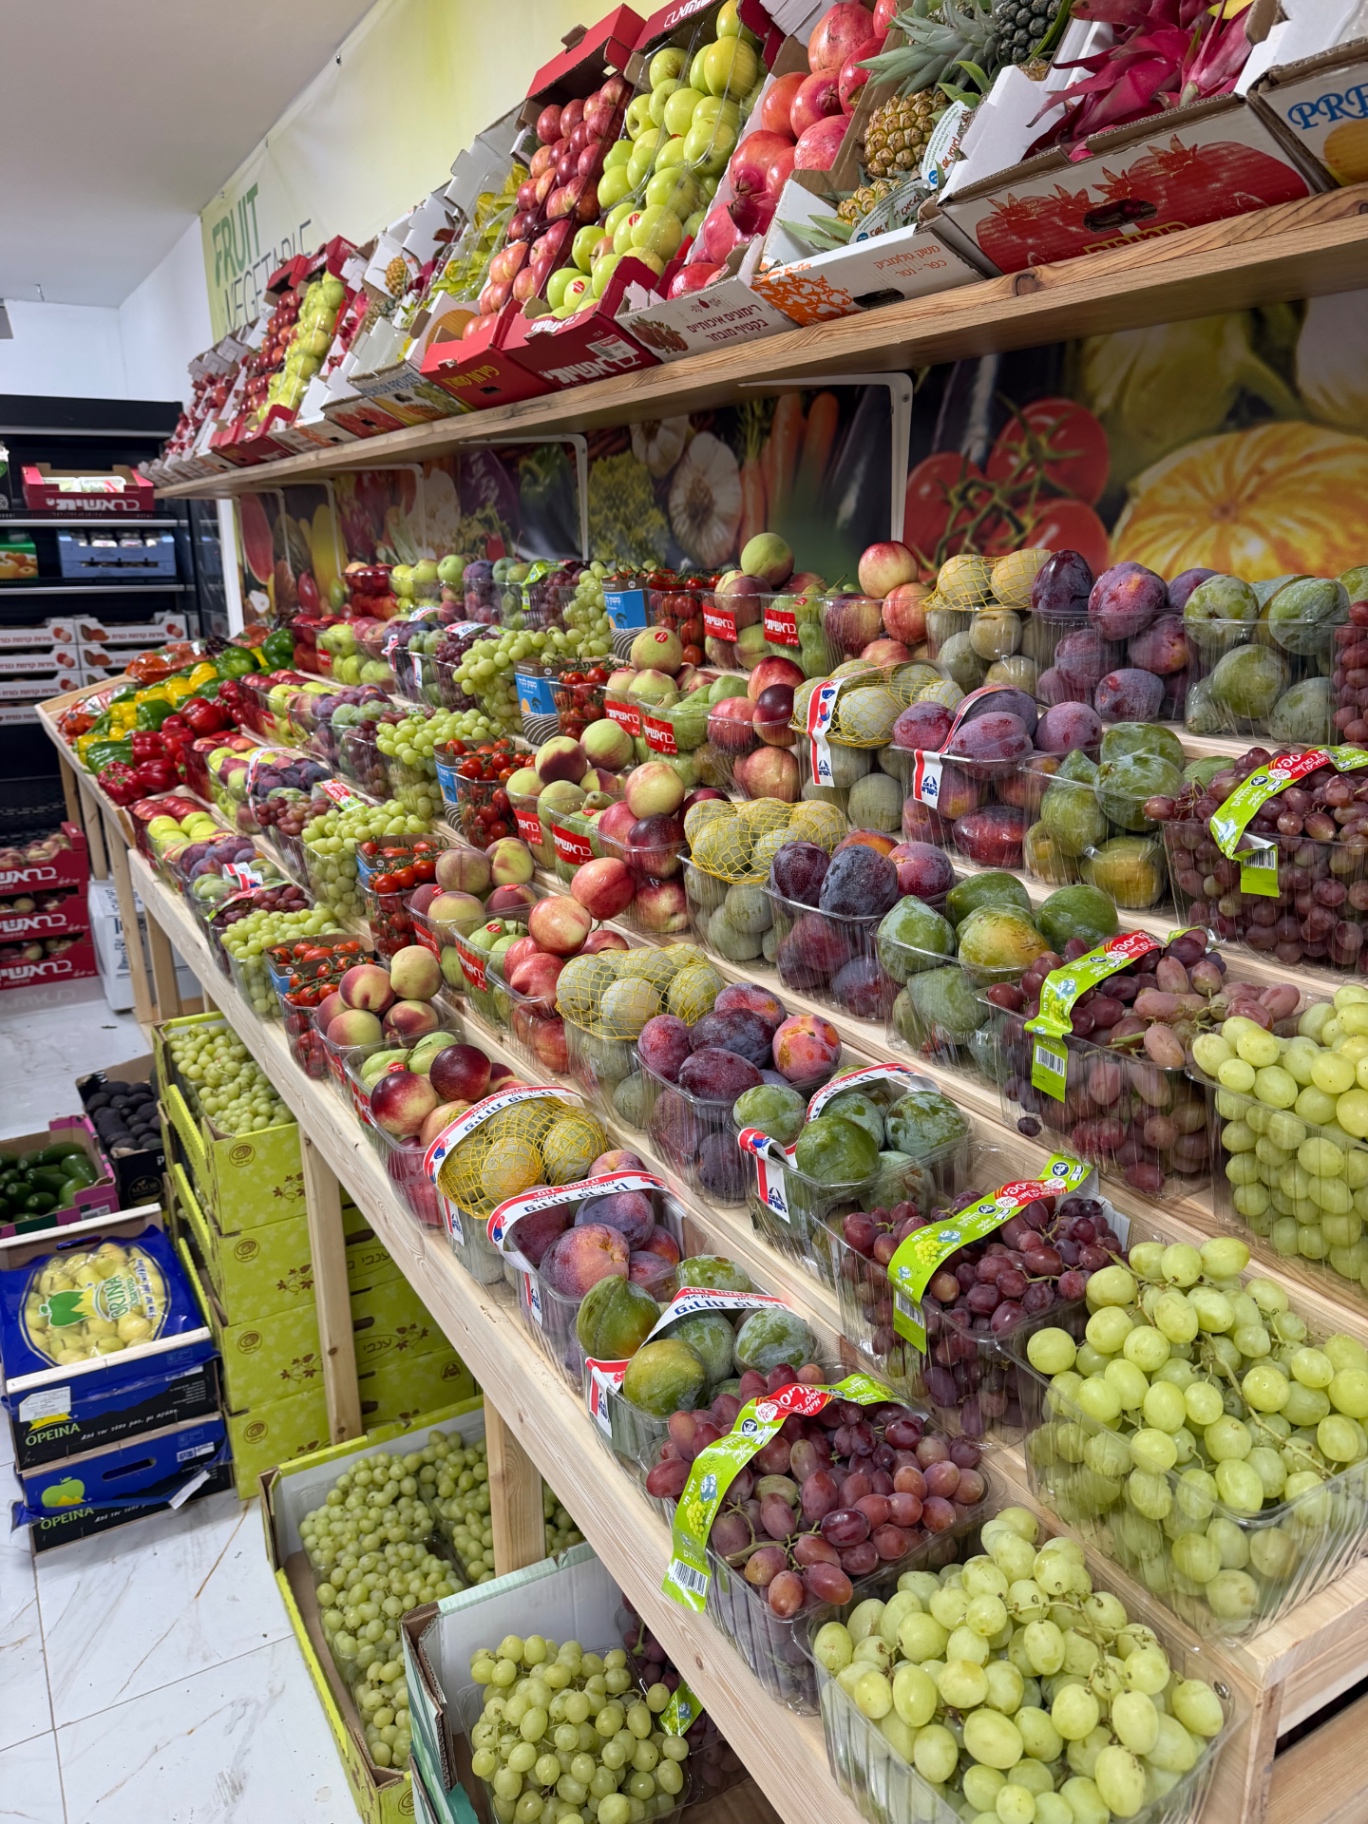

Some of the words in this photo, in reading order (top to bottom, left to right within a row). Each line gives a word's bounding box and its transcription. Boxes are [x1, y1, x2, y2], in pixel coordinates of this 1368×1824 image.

[212, 182, 260, 288] FRUIT
[914, 244, 941, 258] משק
[924, 259, 947, 272] כפר
[724, 304, 763, 322] רימונים
[686, 315, 725, 333] איכותיים
[736, 318, 769, 337] בקטיף
[705, 328, 736, 342] מובחר
[104, 1275, 131, 1319] ORINA
[674, 1300, 725, 1316] פירות
[689, 1479, 698, 1494] דוד
[683, 1495, 690, 1506] חי
